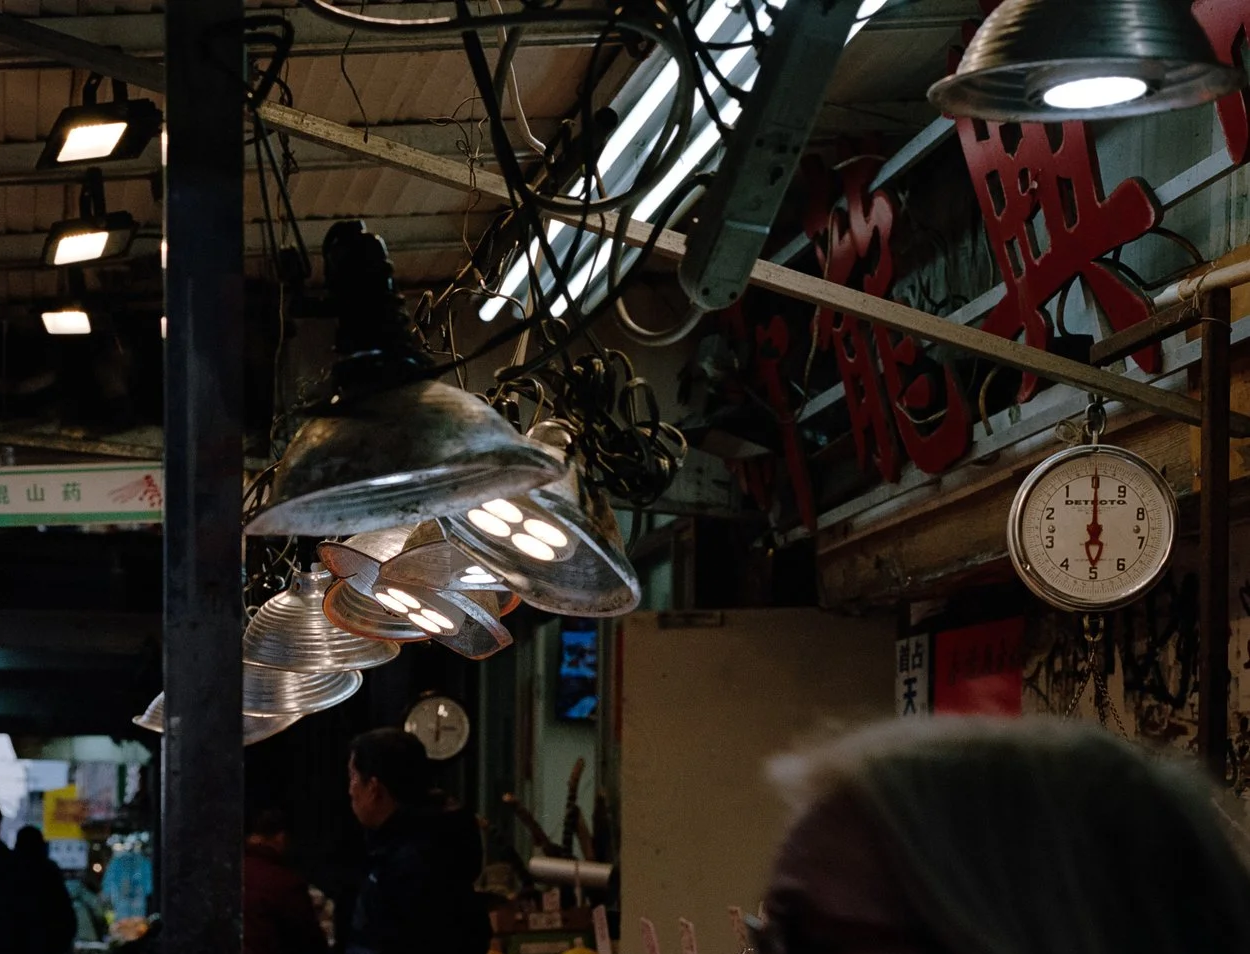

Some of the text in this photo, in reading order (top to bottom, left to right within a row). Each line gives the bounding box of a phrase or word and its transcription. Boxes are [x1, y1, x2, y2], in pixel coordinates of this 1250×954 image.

[1065, 485, 1070, 498] 1
[1117, 485, 1127, 498] 9
[1046, 507, 1055, 520] 2
[1136, 507, 1145, 520] 8
[1045, 535, 1055, 549] 3
[1137, 536, 1146, 549] 7
[1060, 557, 1070, 571] 4
[1116, 558, 1126, 571] 6
[1089, 567, 1098, 580] 5
